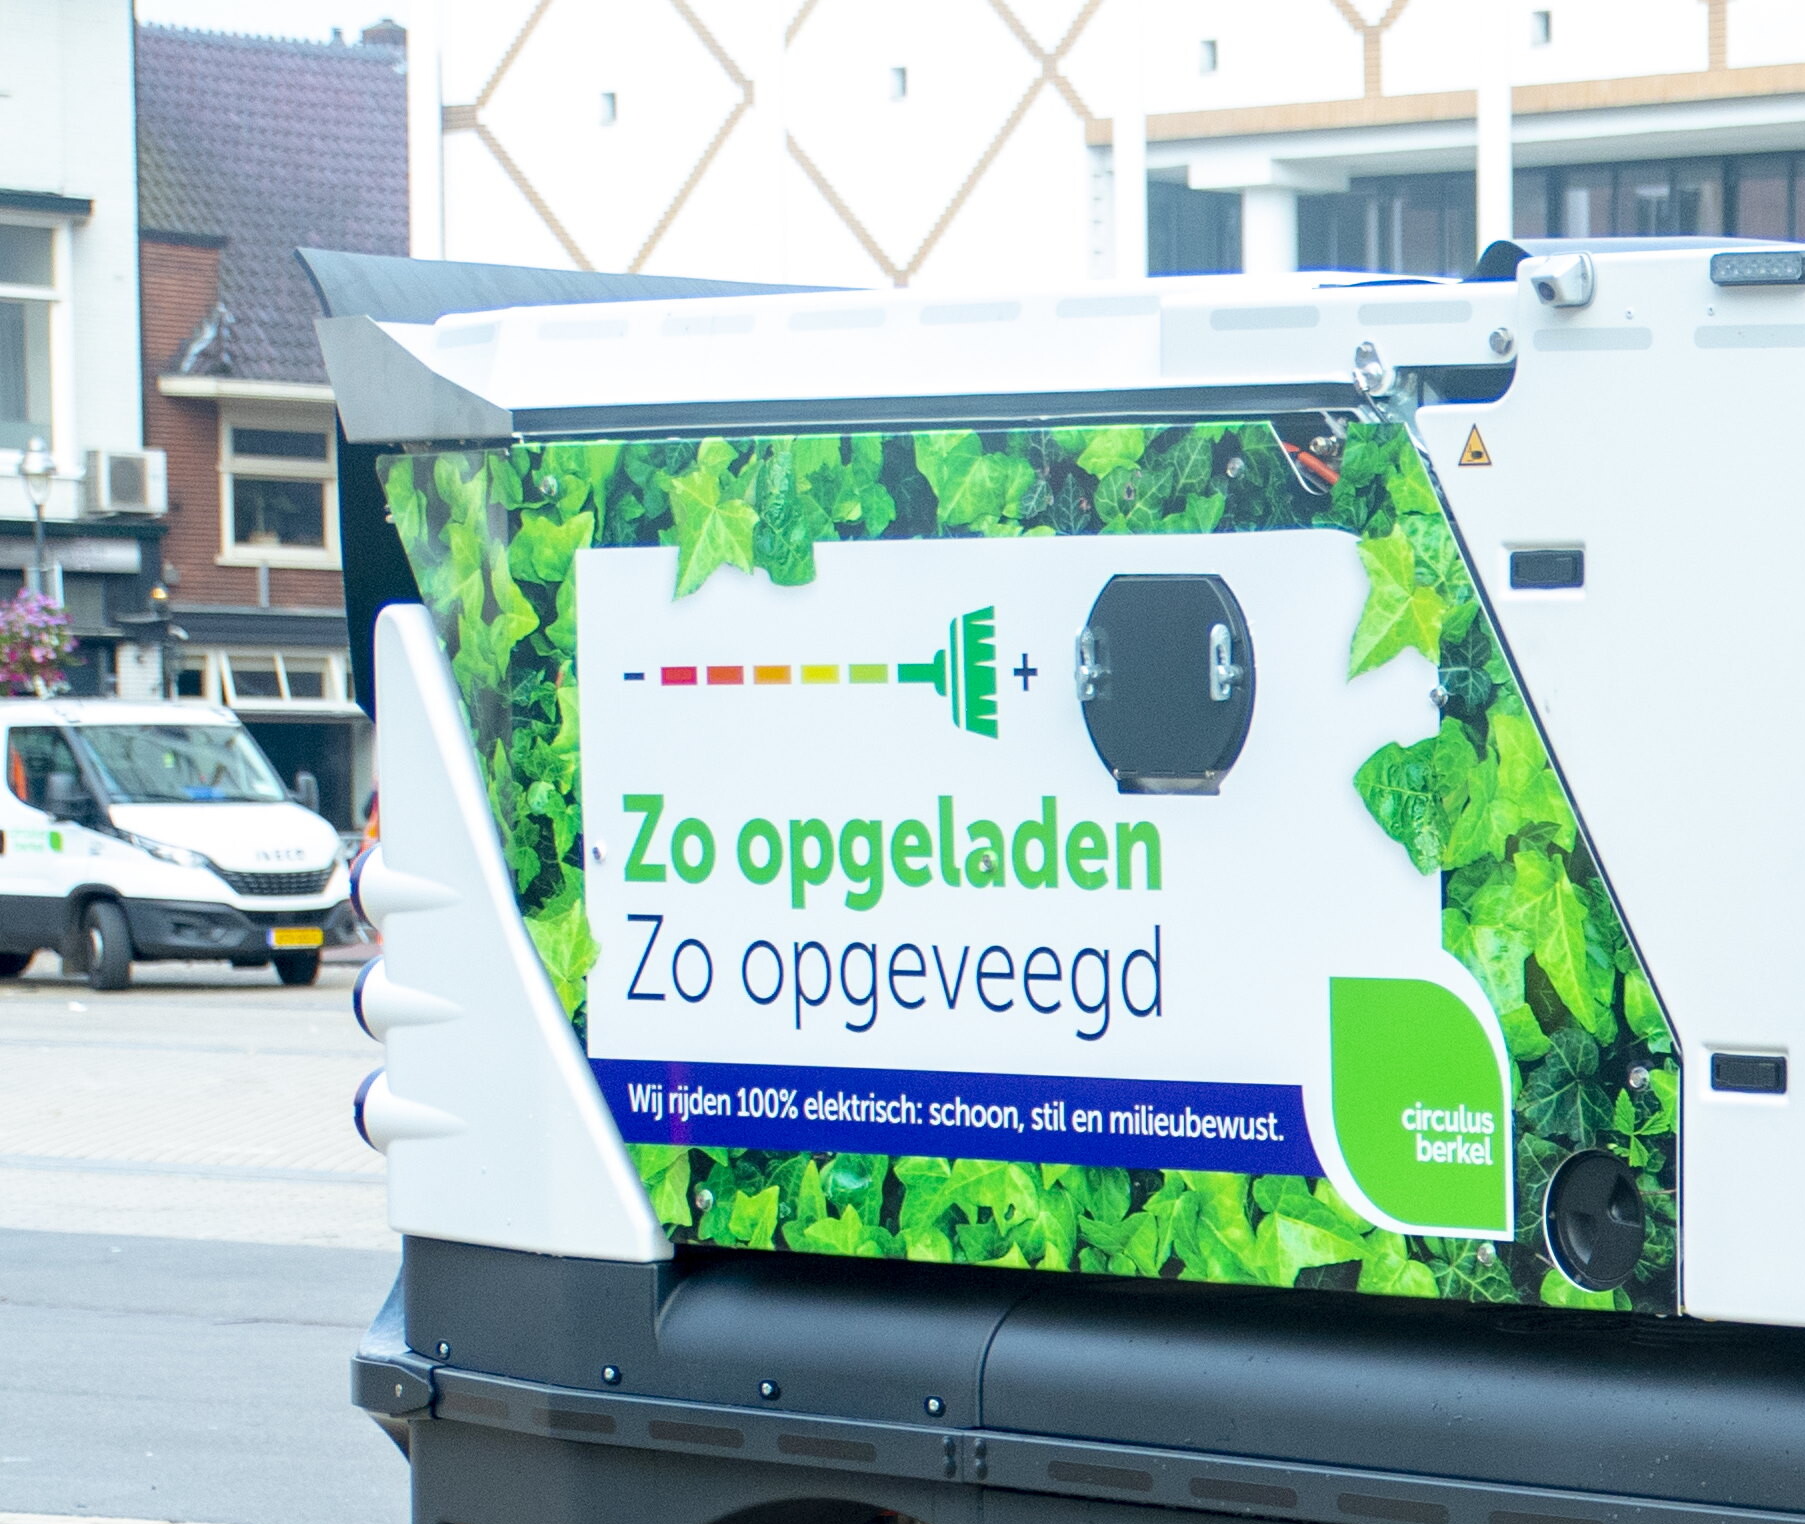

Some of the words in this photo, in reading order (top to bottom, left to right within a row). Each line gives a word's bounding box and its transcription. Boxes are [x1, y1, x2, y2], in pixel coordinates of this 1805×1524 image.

[623, 794, 716, 885] Zo
[737, 795, 1162, 911] opgeladen
[626, 914, 714, 1004] Zo
[741, 924, 1162, 1042] opgeveegd
[628, 1083, 663, 1117] Wij
[668, 1086, 731, 1122] rijden
[737, 1088, 799, 1119] 100%
[803, 1091, 923, 1126] elektrisch:
[929, 1097, 1025, 1133] schoon,
[1031, 1101, 1067, 1132] stil
[1071, 1109, 1103, 1133] en
[1109, 1105, 1285, 1142] milieubewust.
[1401, 1102, 1495, 1133] circulus
[1416, 1133, 1493, 1166] berkel
